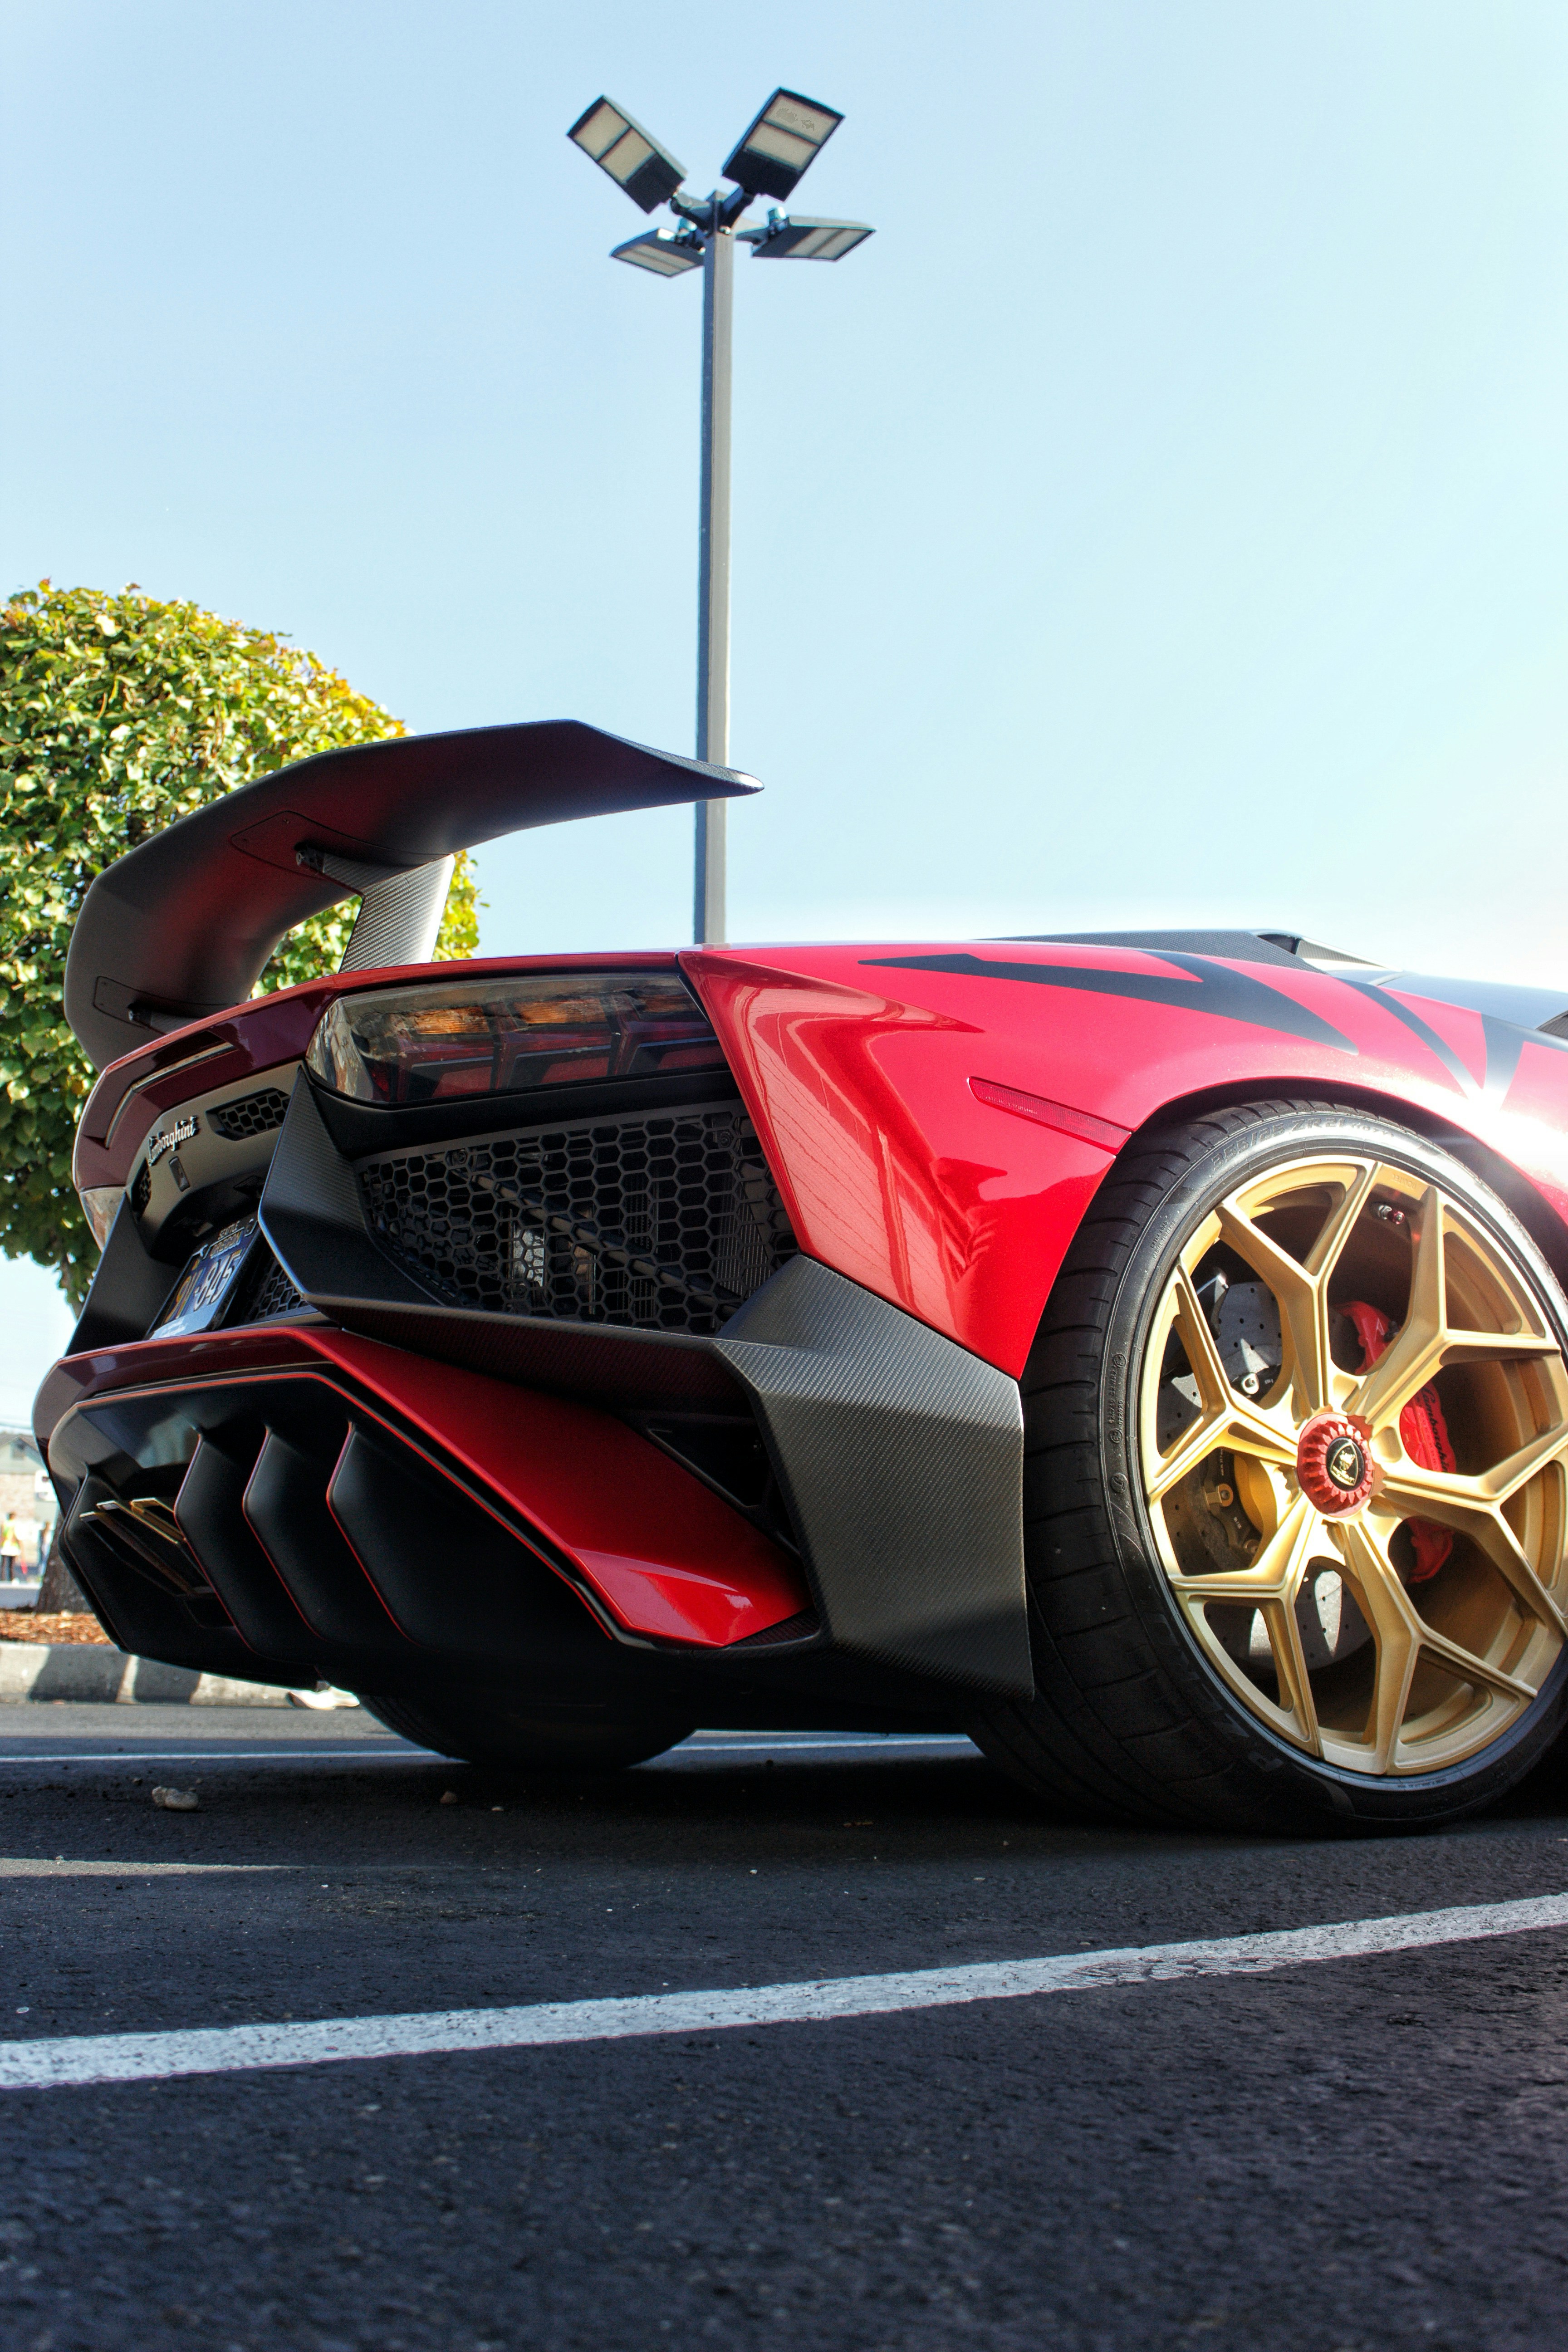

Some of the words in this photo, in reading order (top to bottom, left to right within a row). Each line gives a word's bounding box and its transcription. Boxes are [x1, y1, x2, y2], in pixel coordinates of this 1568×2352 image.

[148, 1116, 196, 1166] Lamborghini
[1211, 1123, 1284, 1171] 355/25
[1291, 1117, 1345, 1132] ZR21
[1421, 1387, 1450, 1472] Lamborghin
